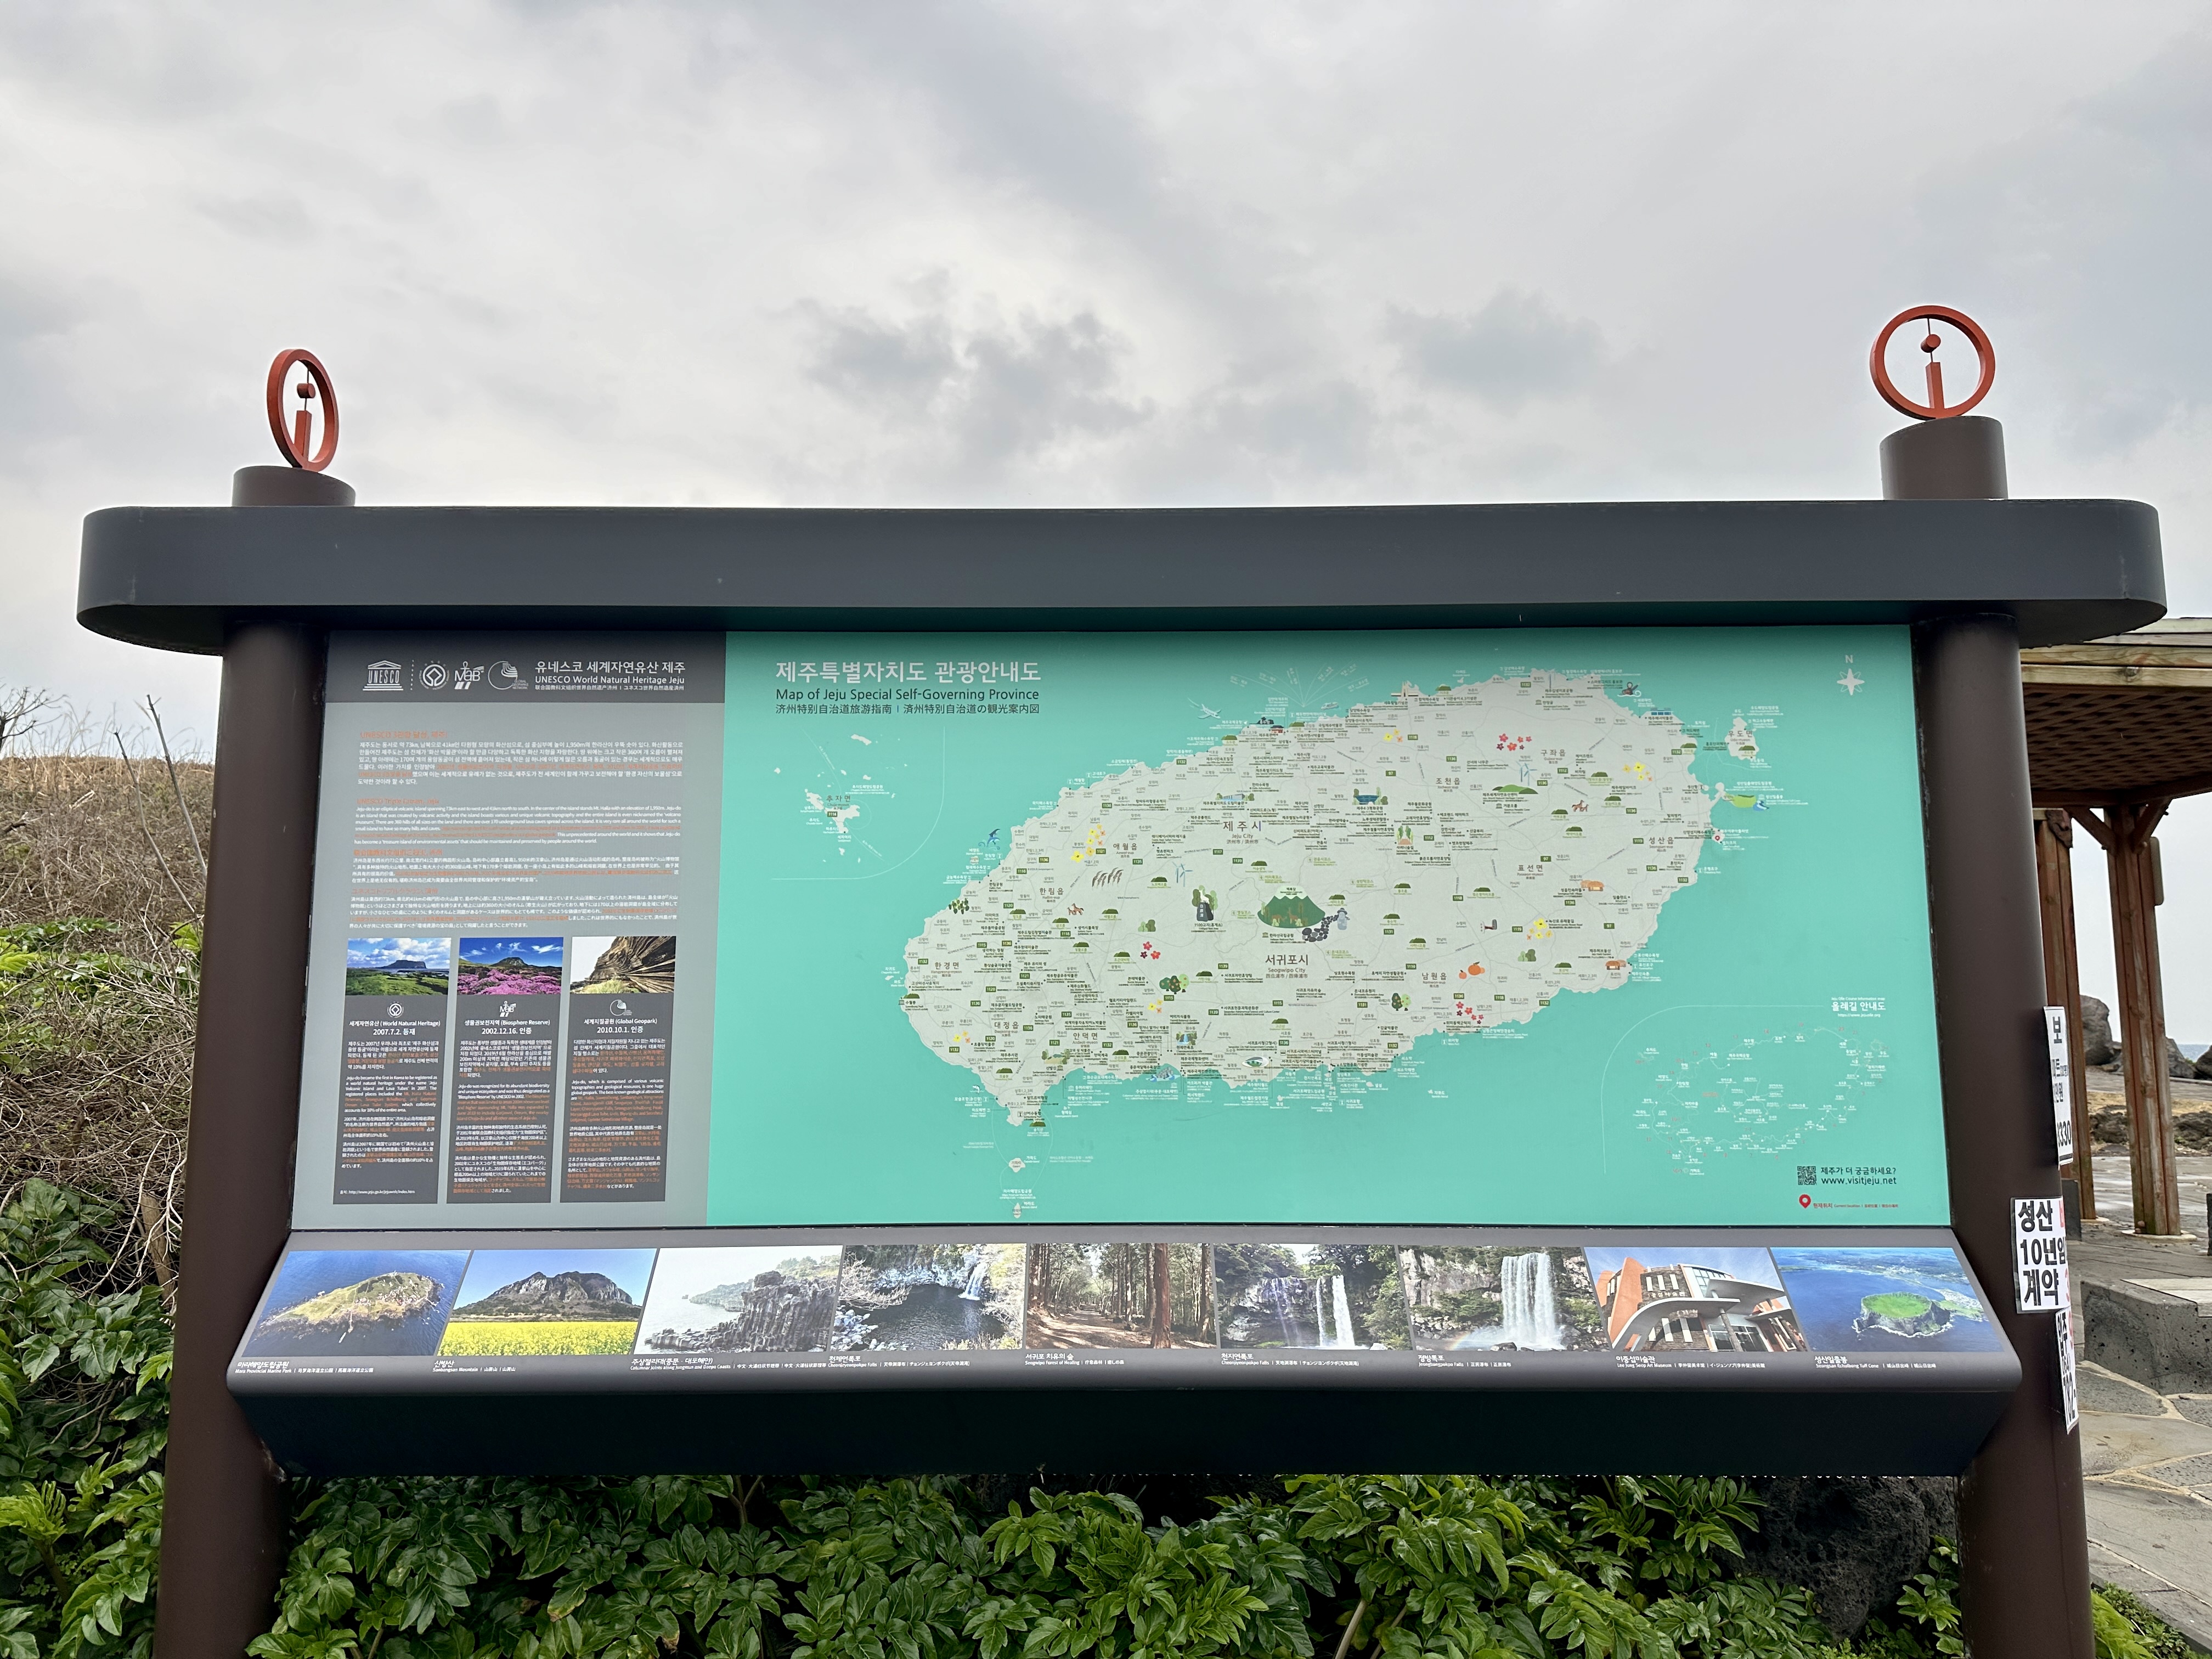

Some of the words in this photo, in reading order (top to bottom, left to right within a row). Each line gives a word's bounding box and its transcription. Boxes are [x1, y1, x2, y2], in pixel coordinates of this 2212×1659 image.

[1845, 655, 1854, 663] N
[535, 661, 583, 674] 유네스코
[586, 661, 659, 674] 세계자연유산
[662, 661, 686, 674] 제주
[776, 661, 927, 684] 제주특별자치도
[935, 661, 1041, 684] 관광안내도
[368, 669, 400, 684] UNESCO
[633, 676, 667, 685] Heritage
[669, 676, 685, 685] Jeju
[776, 690, 803, 701] Map
[808, 689, 820, 700] of
[823, 689, 846, 702] Jeju
[850, 689, 891, 702] Special
[896, 689, 984, 701] Self-Governing
[989, 689, 1039, 699] Province
[776, 704, 892, 714] 济州特别自治道旅游指南
[903, 704, 1039, 714] 済州特別自治道の観光案内図
[1223, 821, 1261, 832] 제주시
[1039, 887, 1064, 895] 한림읍
[1265, 955, 1308, 966] 서귀포시
[1831, 1002, 1857, 1012] 올레길
[1860, 1002, 1886, 1012] 안내도
[1821, 1167, 1843, 1175] 제주가
[1846, 1167, 1852, 1175] 더
[1855, 1167, 1896, 1175] 궁금하세요?
[1821, 1176, 1897, 1185] www.visitjeju.net
[2018, 1200, 2053, 1232] 성산
[2023, 1268, 2059, 1306] 계약
[1814, 1356, 1847, 1364] 성산일출봉
